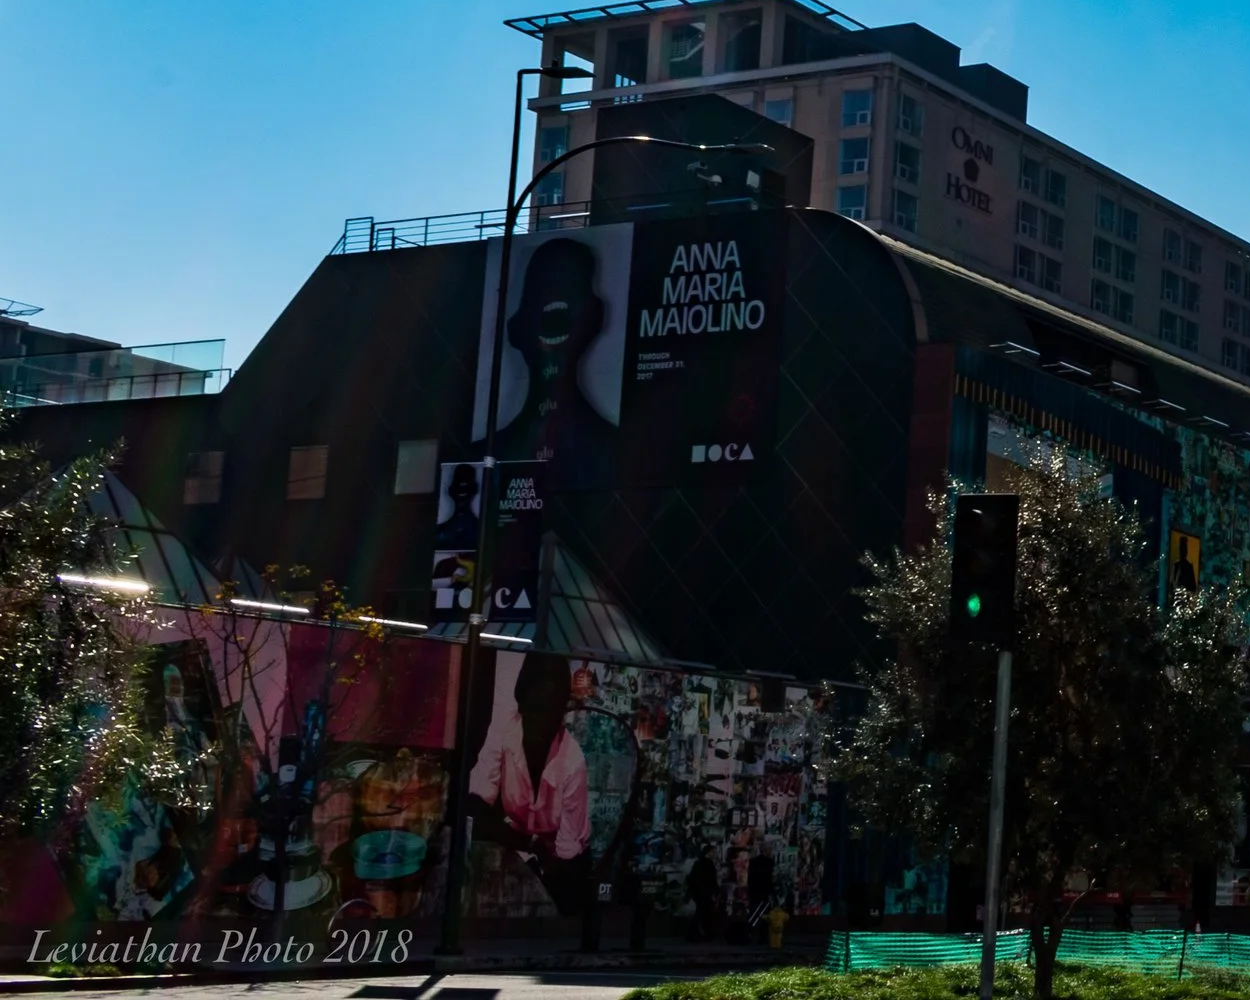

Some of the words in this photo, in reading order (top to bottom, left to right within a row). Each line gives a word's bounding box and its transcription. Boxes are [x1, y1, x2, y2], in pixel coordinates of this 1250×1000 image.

[952, 126, 993, 165] OMNI
[945, 172, 993, 214] HOTEL
[668, 240, 741, 274] ANNA
[662, 271, 746, 305] MARIA
[639, 299, 766, 338] MAIOLINO
[506, 488, 536, 499] MARIA
[508, 477, 535, 489] ANNA
